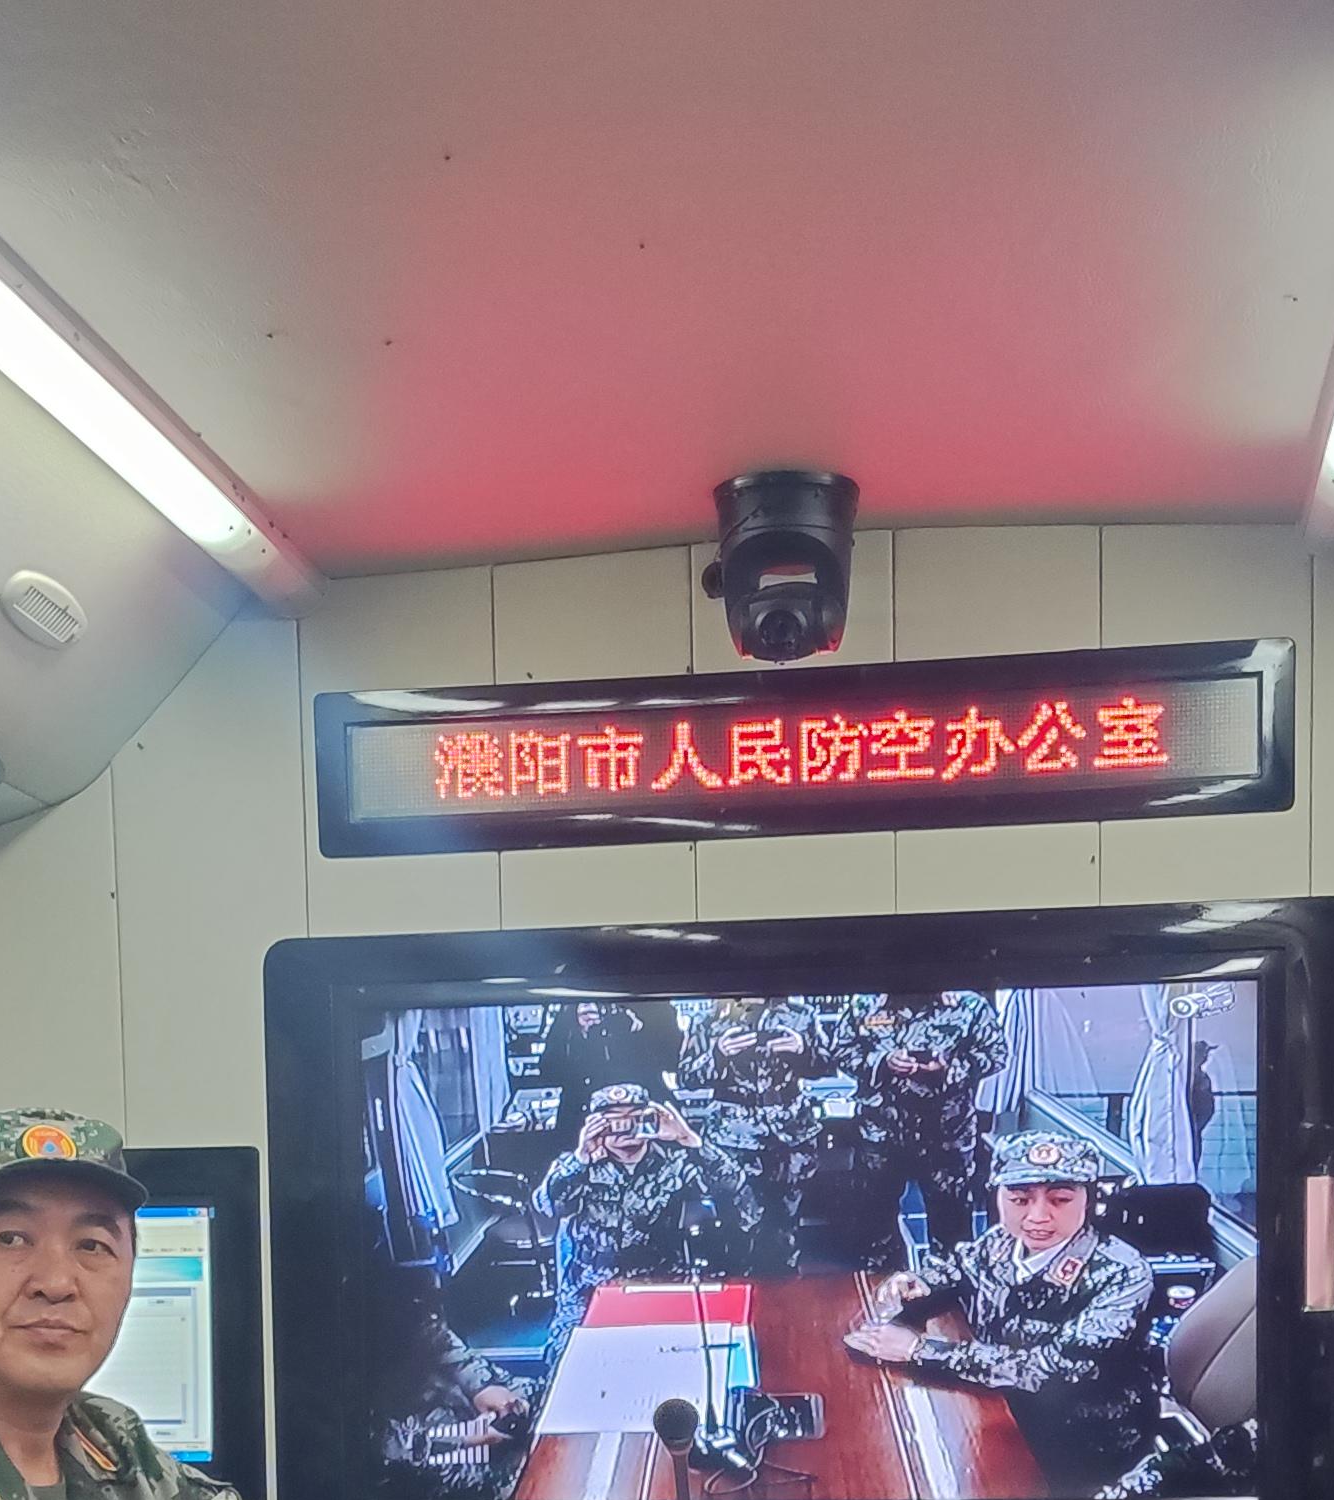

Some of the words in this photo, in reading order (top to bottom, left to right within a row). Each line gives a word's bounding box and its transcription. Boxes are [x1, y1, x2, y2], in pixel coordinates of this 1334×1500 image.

[434, 696, 1169, 799] 濮阳市人民防空办公室
